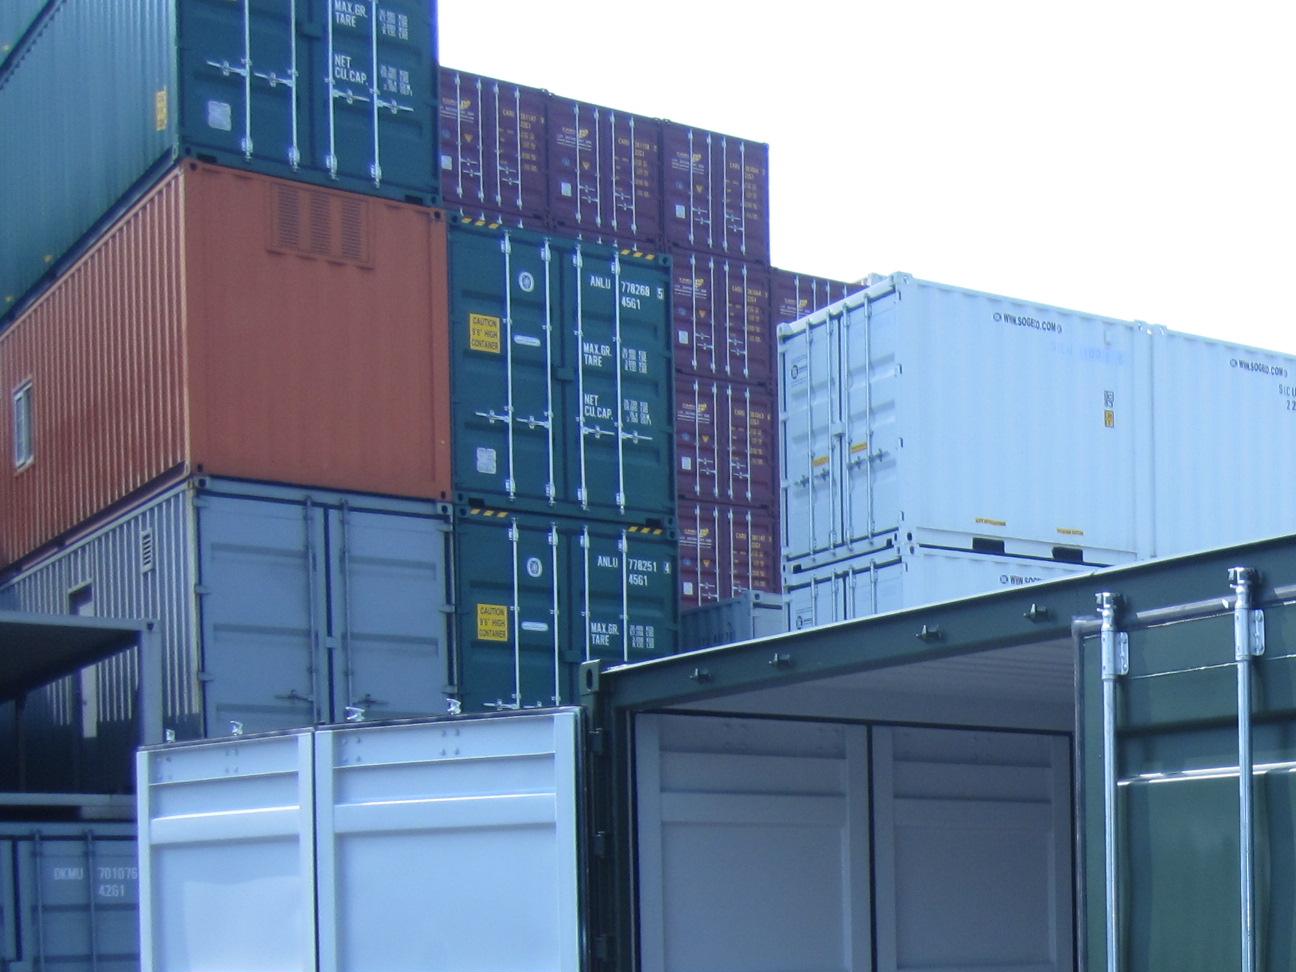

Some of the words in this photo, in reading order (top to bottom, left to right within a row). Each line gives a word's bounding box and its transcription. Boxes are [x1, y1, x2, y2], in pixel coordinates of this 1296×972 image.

[335, 11, 356, 28] TARE
[334, 54, 352, 69] NET
[590, 274, 611, 290] ANLU
[584, 353, 603, 367] TARE
[584, 393, 599, 407] NET
[597, 555, 619, 568] ANLU
[628, 558, 657, 573] 778251
[591, 634, 610, 647] TARE
